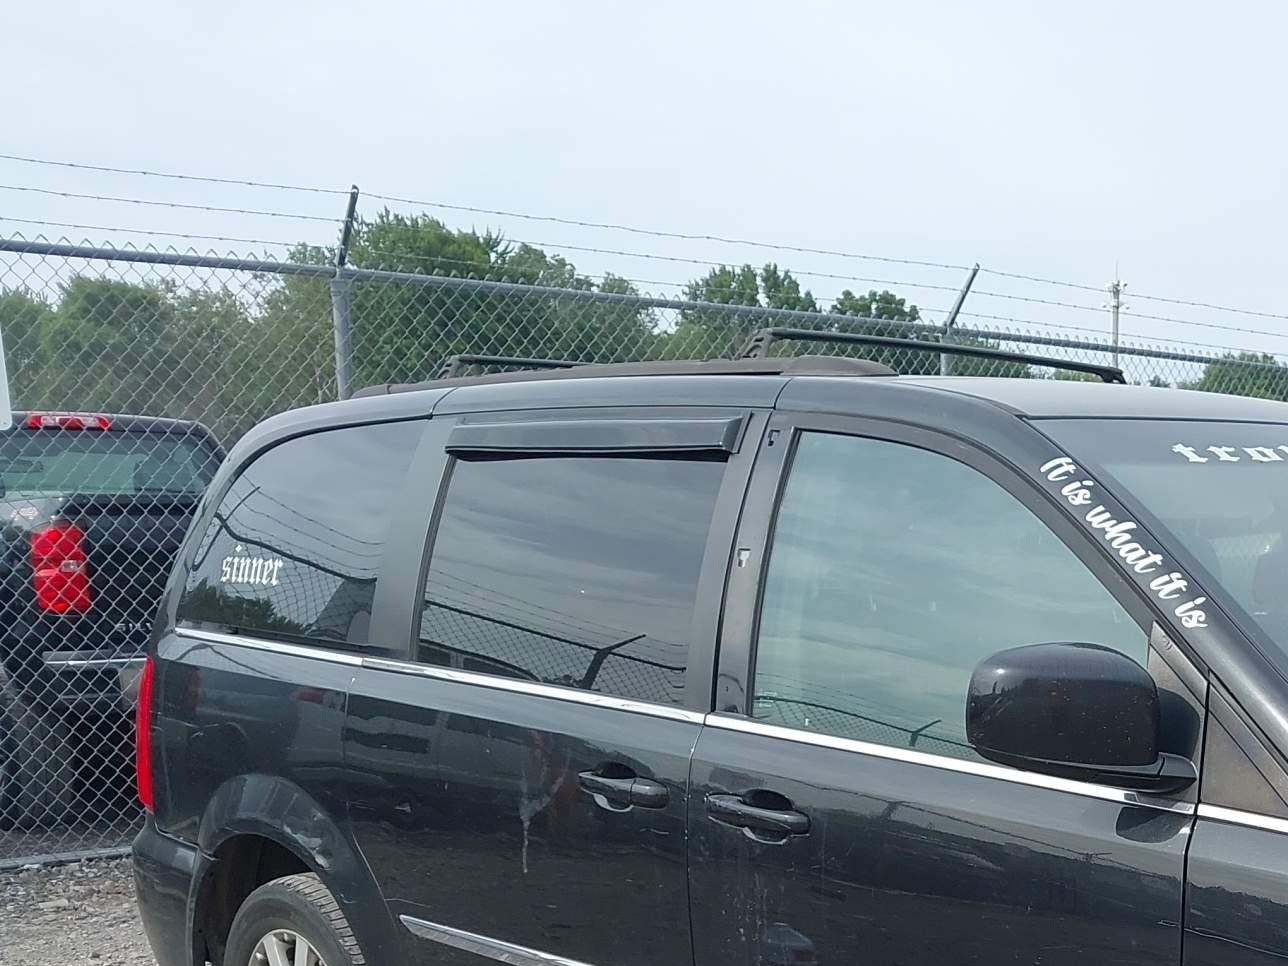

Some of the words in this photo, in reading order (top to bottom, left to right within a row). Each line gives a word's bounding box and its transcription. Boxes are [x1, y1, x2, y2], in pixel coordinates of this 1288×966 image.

[220, 545, 284, 586] sinner
[1039, 456, 1077, 481] It
[1061, 480, 1094, 506] is
[1085, 505, 1163, 573] what
[1149, 572, 1188, 600] it
[1174, 596, 1208, 628] is
